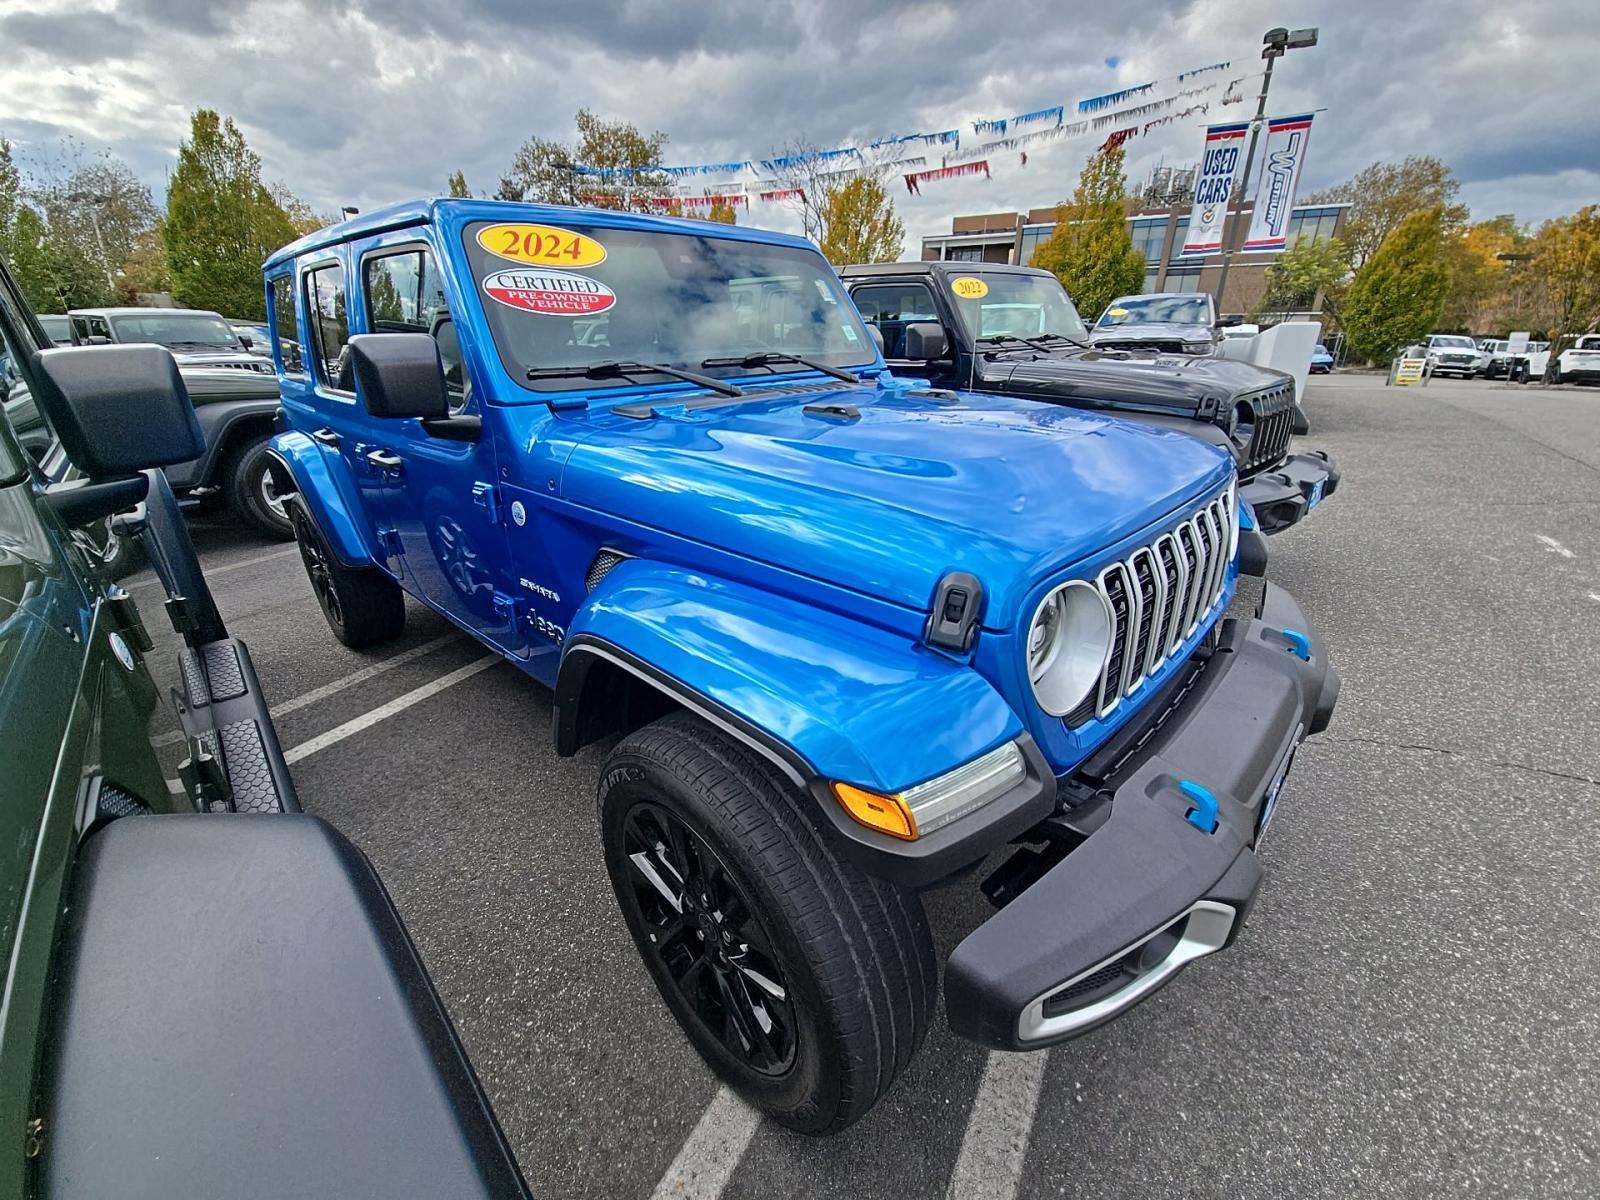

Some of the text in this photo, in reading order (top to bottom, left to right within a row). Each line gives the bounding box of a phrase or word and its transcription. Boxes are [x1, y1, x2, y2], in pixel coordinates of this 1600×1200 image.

[1204, 148, 1238, 175] USED
[1197, 177, 1231, 204] CARS
[1265, 133, 1301, 236] WESTBURY
[502, 230, 581, 259] 2024
[497, 275, 599, 293] CERTIFIED
[958, 281, 982, 295] 2022
[508, 290, 599, 303] PRE-OWNED
[525, 299, 590, 310] VEHICLE
